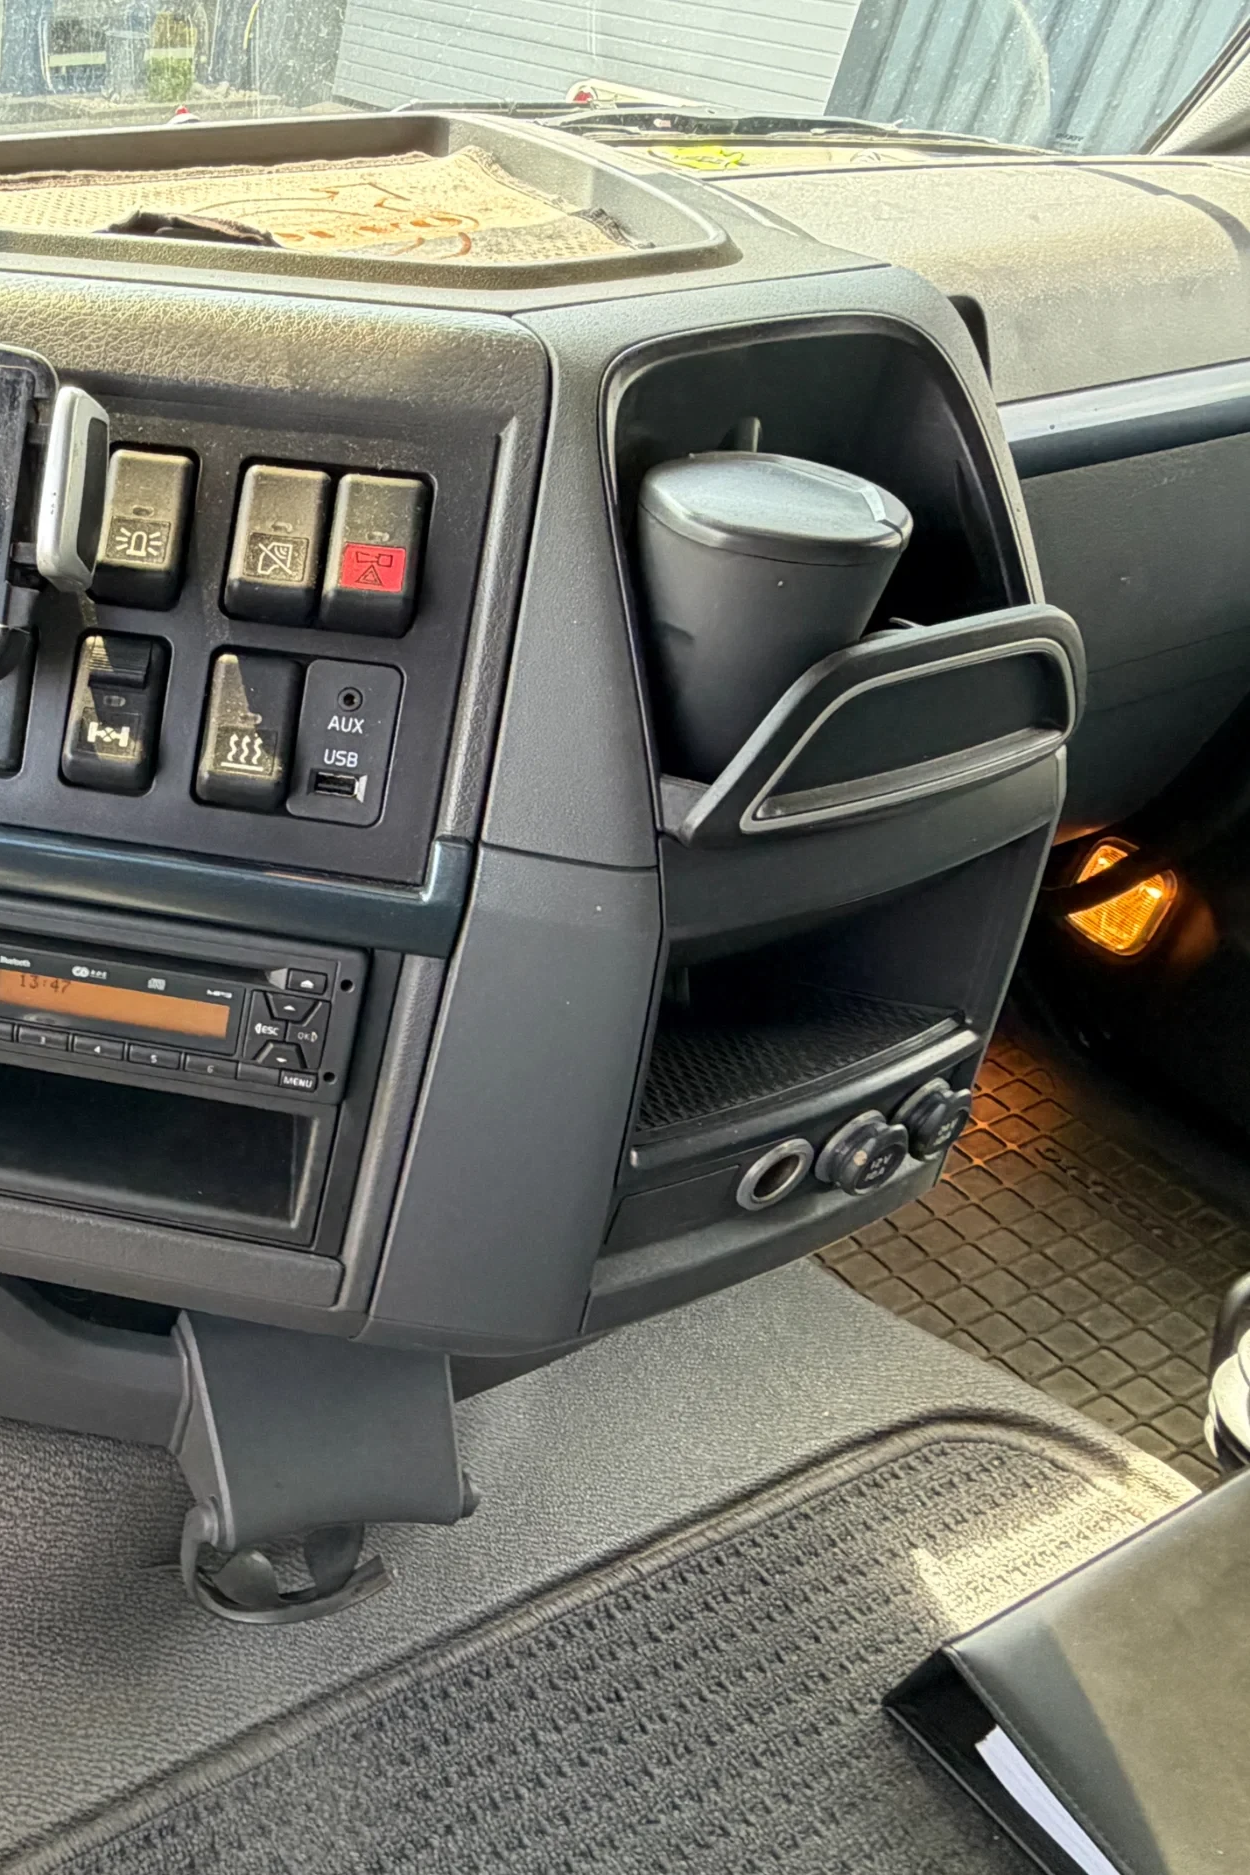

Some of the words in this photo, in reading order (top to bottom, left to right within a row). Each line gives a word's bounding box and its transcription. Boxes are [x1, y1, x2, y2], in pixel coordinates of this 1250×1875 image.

[327, 715, 365, 734] AUX
[323, 748, 359, 768] USB
[20, 974, 71, 994] 13:47
[283, 1076, 313, 1089] MENU
